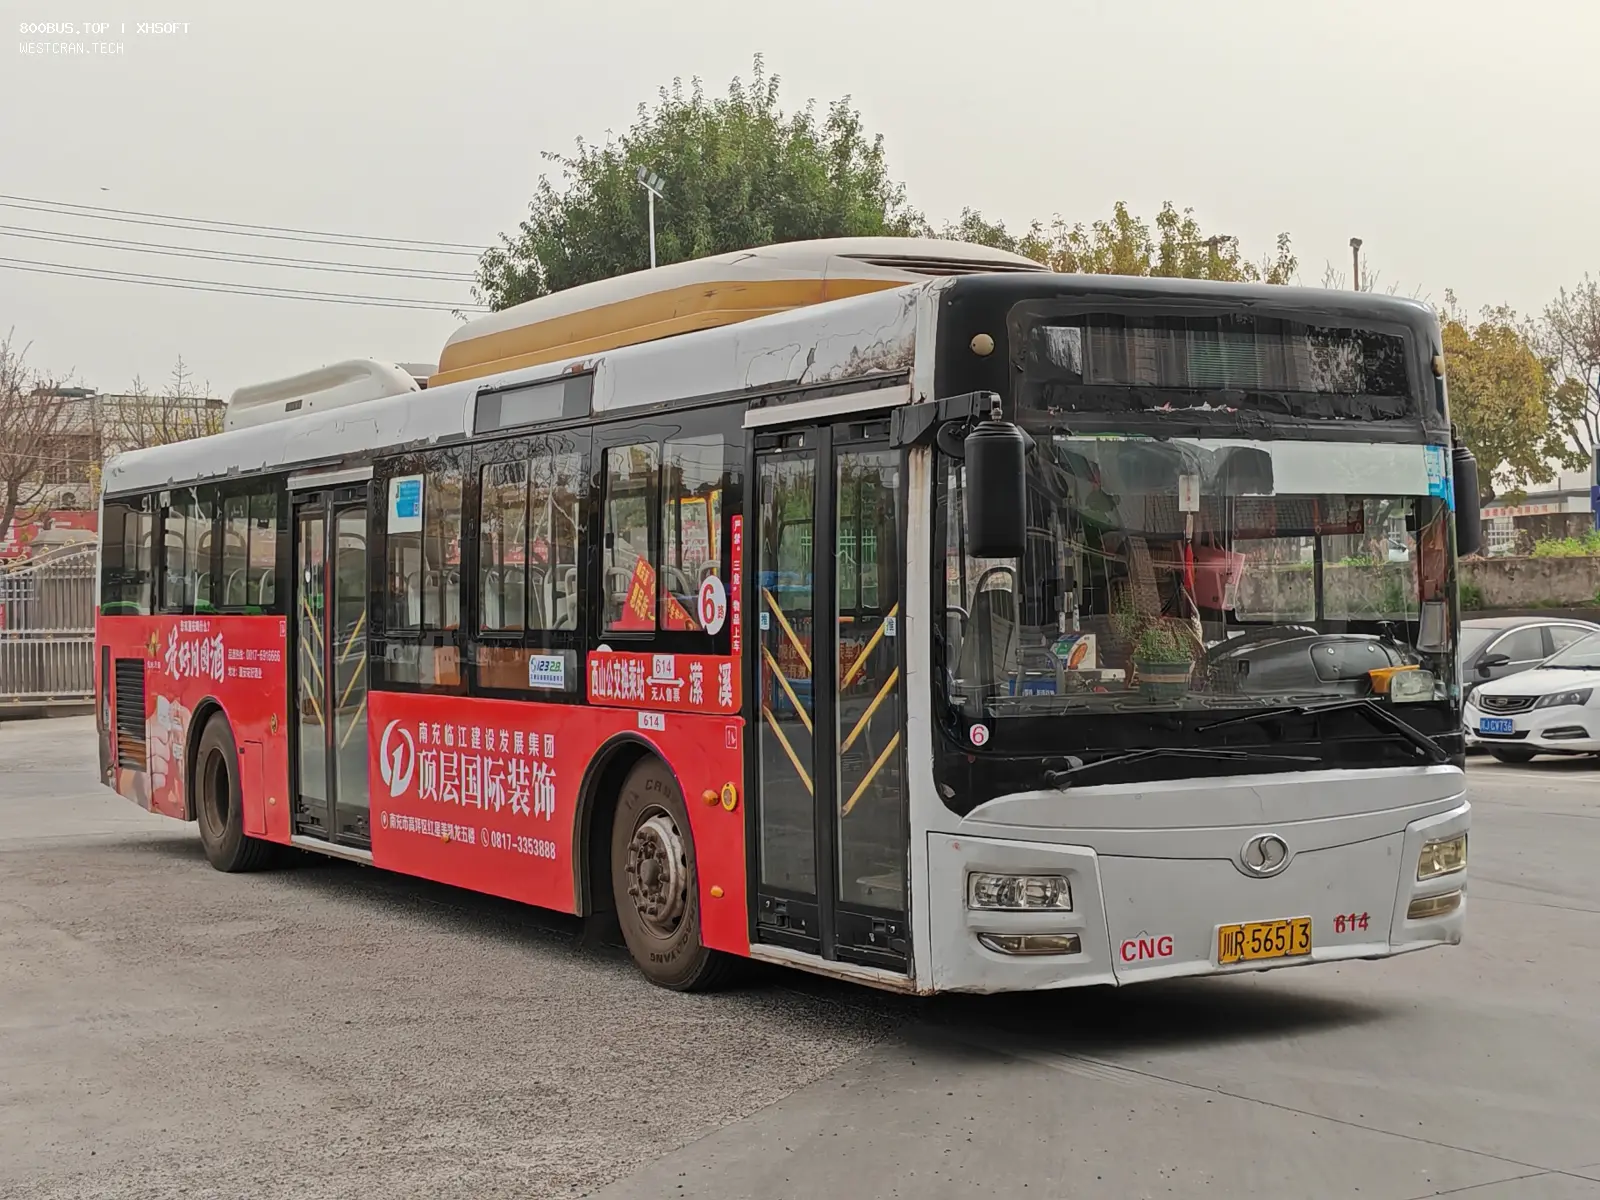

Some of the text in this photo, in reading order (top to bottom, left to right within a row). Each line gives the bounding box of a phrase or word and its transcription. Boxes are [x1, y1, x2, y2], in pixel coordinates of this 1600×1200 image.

[590, 659, 645, 701] 西山公交换乘站
[655, 659, 672, 674] 614
[643, 716, 660, 728] 614
[972, 726, 985, 744] 6
[418, 721, 555, 759] 南充临江建设发展集团
[417, 747, 557, 822] 顶层国际装饰
[490, 830, 556, 860] 0817-3353888
[1334, 912, 1369, 934] 614
[1120, 936, 1174, 962] CNG
